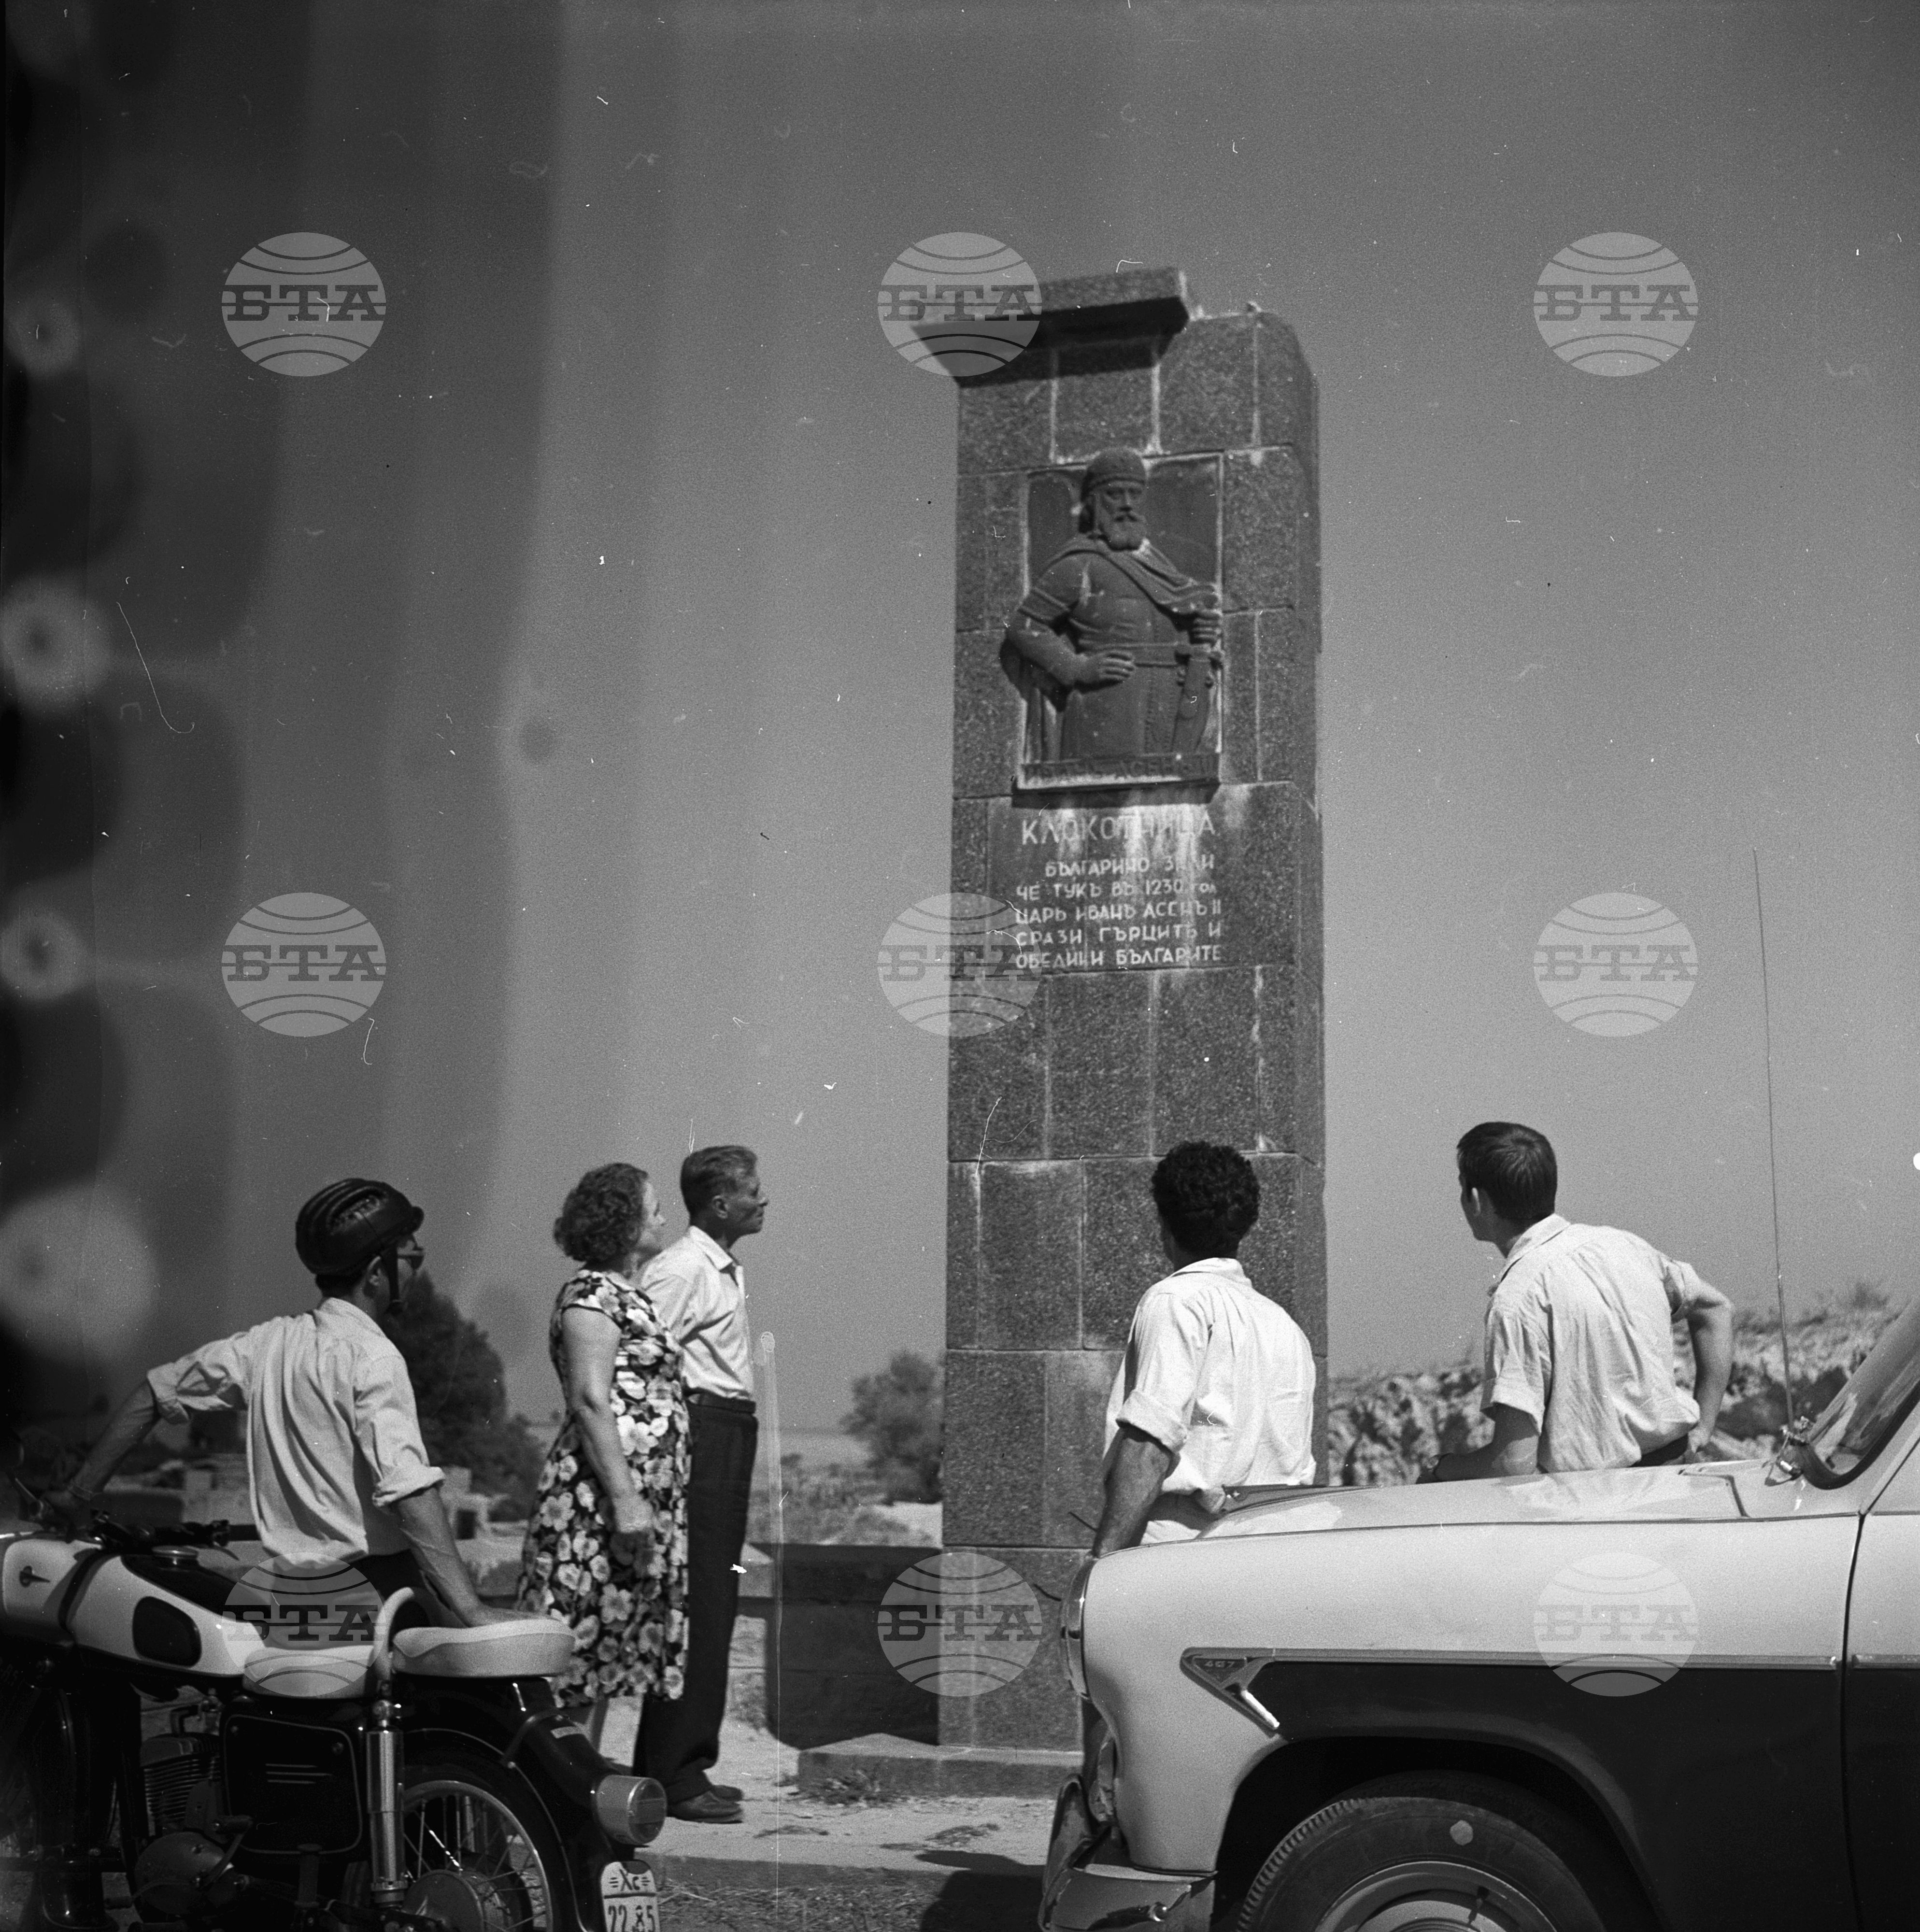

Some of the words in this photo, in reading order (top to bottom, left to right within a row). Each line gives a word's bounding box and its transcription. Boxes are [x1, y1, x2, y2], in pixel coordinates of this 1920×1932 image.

[1016, 884, 1040, 901] ЧЕ
[1053, 882, 1102, 898] ТУКЪ
[1146, 879, 1183, 895] 1230
[1016, 928, 1082, 946] СРАЗИ
[1208, 921, 1222, 937] И
[1116, 944, 1222, 965] БЪЛГАРИТЕ
